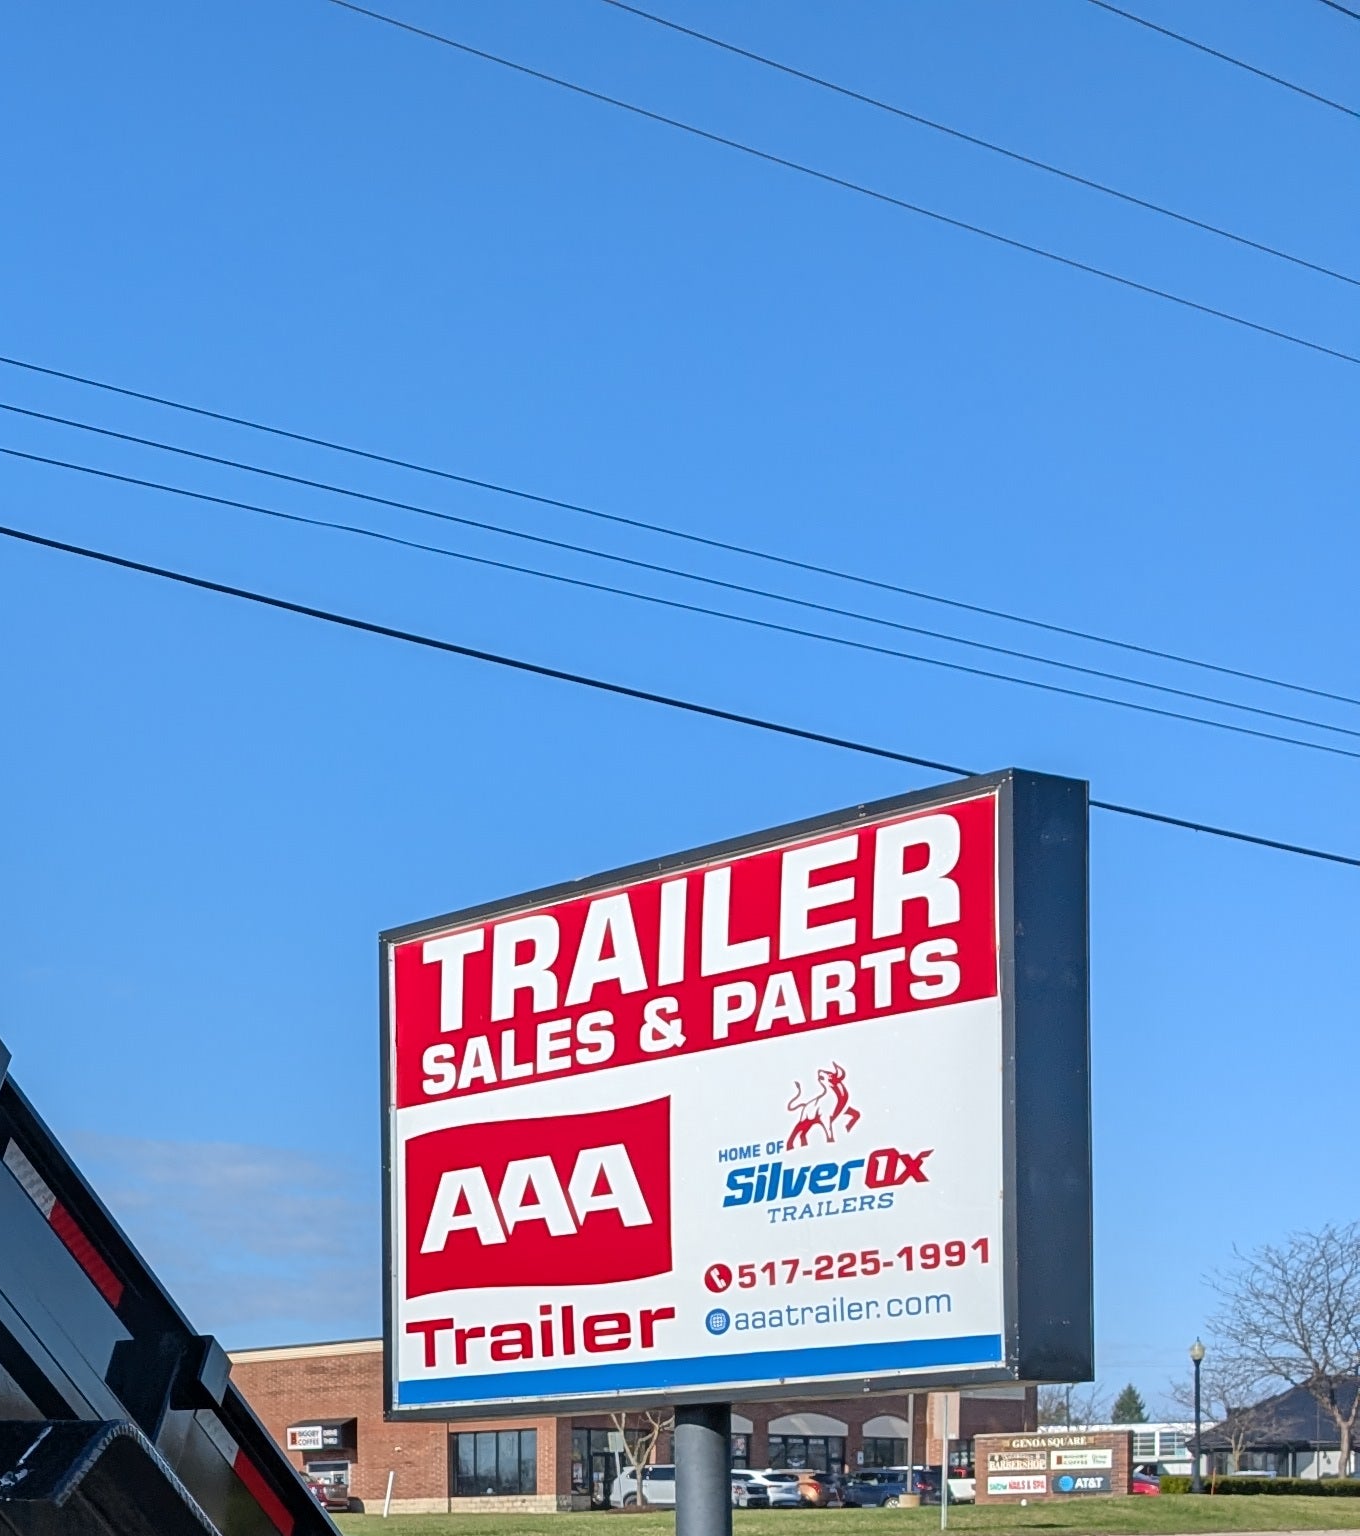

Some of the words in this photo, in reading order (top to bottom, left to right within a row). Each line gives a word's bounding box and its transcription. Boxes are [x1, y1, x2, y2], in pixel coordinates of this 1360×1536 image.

[422, 814, 961, 1033] TRAILER
[422, 1010, 615, 1096] SALES
[639, 996, 686, 1052] &
[712, 937, 961, 1040] PARTS
[718, 1143, 761, 1163] HOME
[766, 1140, 785, 1154] OF
[420, 1143, 653, 1254] AAA
[767, 1192, 894, 1223] TRAILERS
[738, 1237, 989, 1289] 517-225-1991
[734, 1293, 953, 1331] aaatrailer.com
[406, 1304, 676, 1368] Trailer
[1012, 1438, 1046, 1449] GENOA
[1047, 1436, 1087, 1447] SQUARE
[989, 1460, 1046, 1471] BARBERSHOP
[1008, 1480, 1025, 1490] NAILS
[1033, 1480, 1045, 1489] SPA
[1074, 1477, 1104, 1489] AT&T
